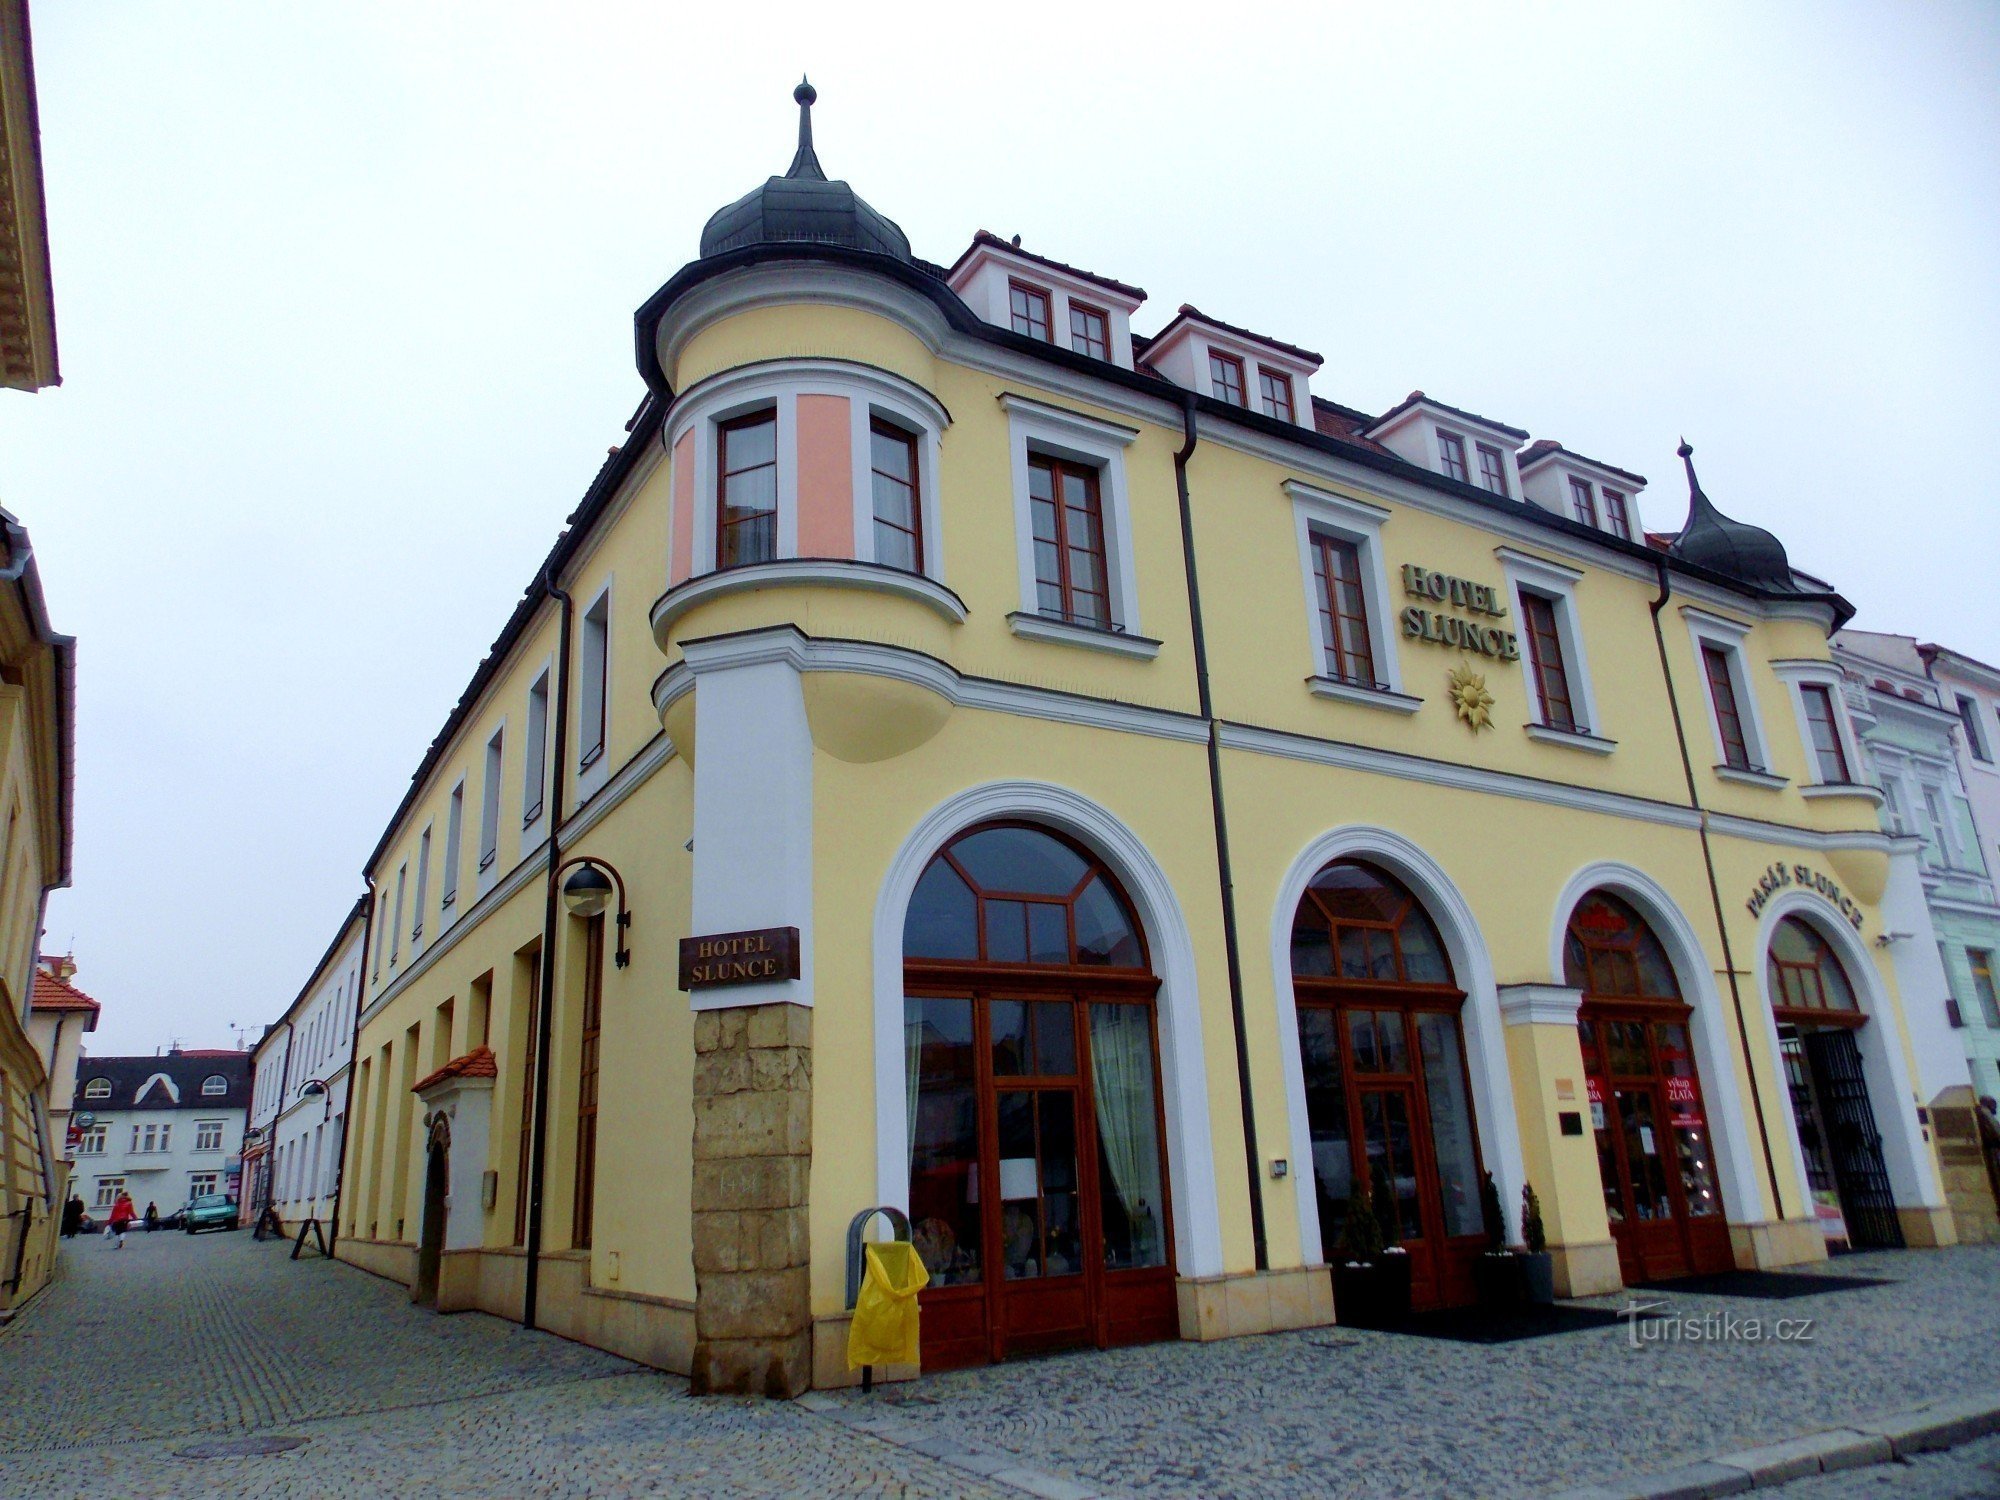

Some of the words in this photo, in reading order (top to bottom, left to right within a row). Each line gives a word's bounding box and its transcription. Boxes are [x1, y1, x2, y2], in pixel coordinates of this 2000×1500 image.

[1401, 564, 1507, 618] HOTEL
[1401, 606, 1520, 661] SLUNCE
[1793, 864, 1863, 930] SLUNCE
[699, 936, 771, 958] HOTEL
[692, 958, 776, 983] SLUNCE
[1668, 1077, 1690, 1090] výkup
[1668, 1089, 1694, 1101] ZLATA
